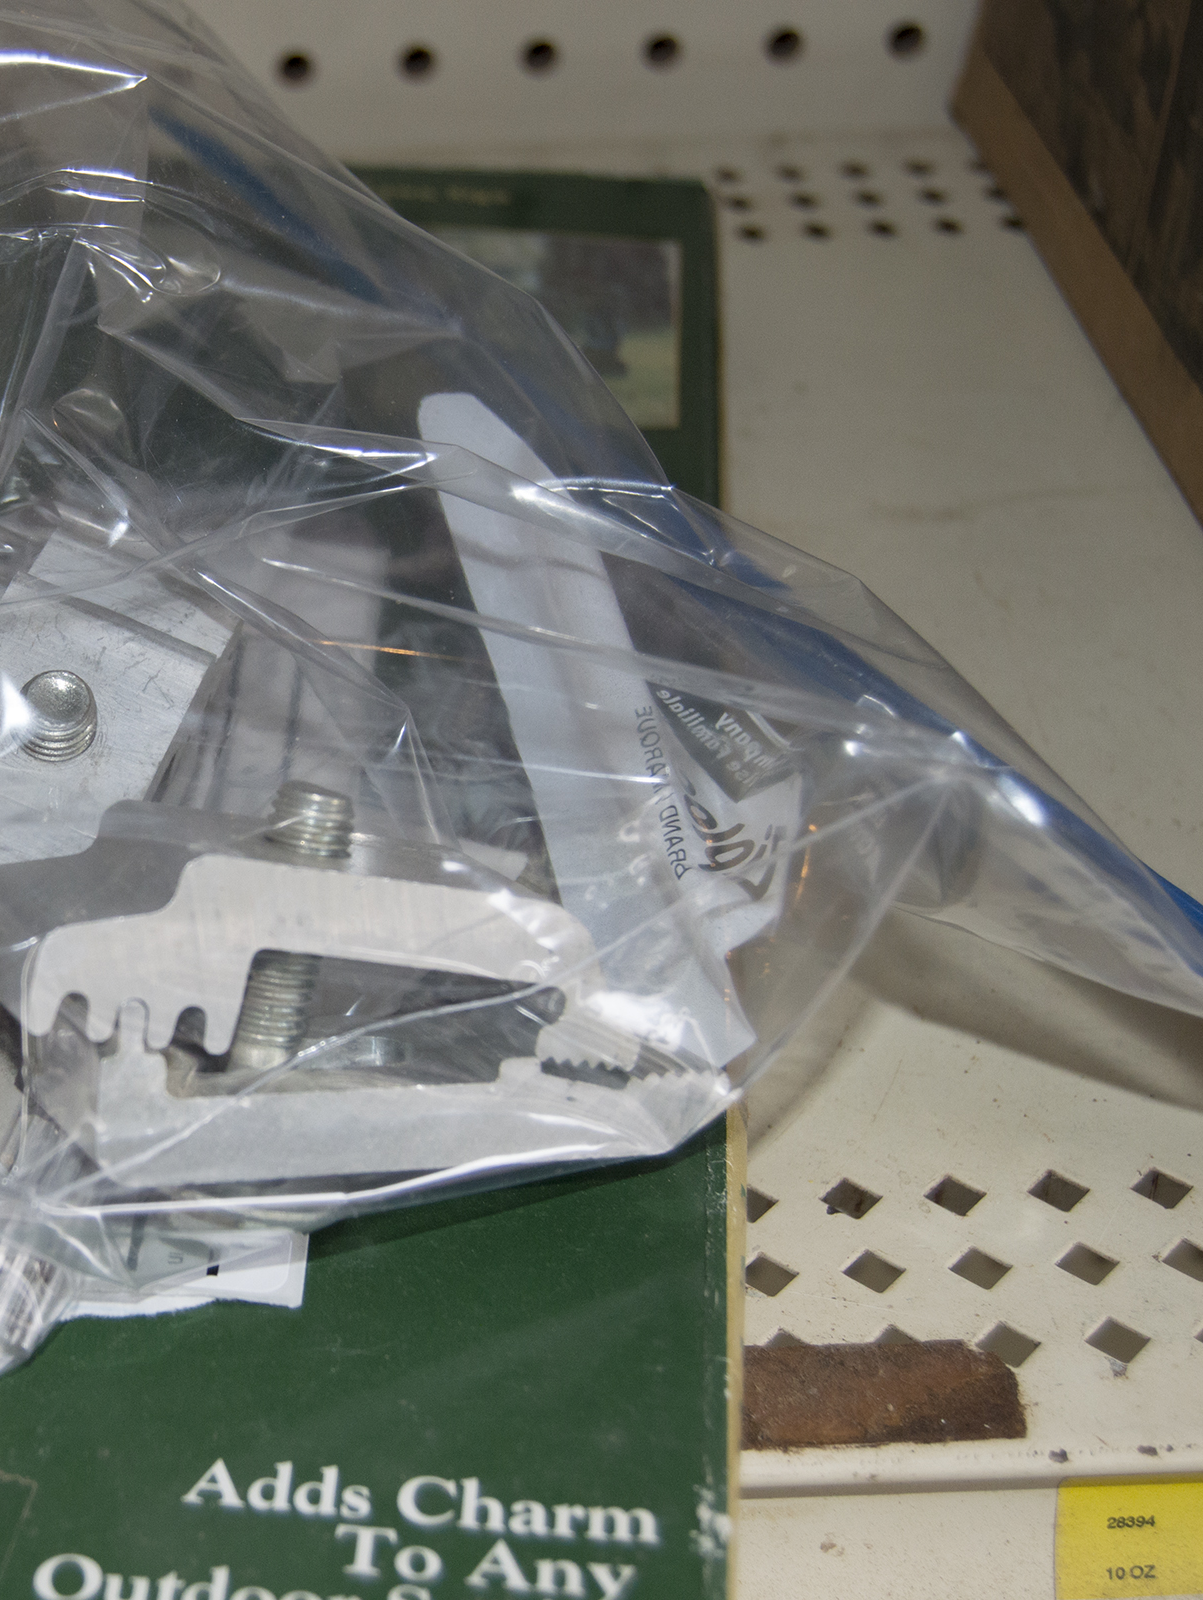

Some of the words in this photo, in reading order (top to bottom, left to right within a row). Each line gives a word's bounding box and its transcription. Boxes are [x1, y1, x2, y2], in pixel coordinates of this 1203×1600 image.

[182, 1457, 374, 1520] Adds
[396, 1475, 661, 1546] Charm
[1107, 1515, 1156, 1529] 28394
[32, 1552, 361, 1600] Outd
[335, 1523, 444, 1582] To
[465, 1538, 637, 1600] Any
[1106, 1567, 1126, 1580] 10
[1130, 1565, 1156, 1579] OZ
